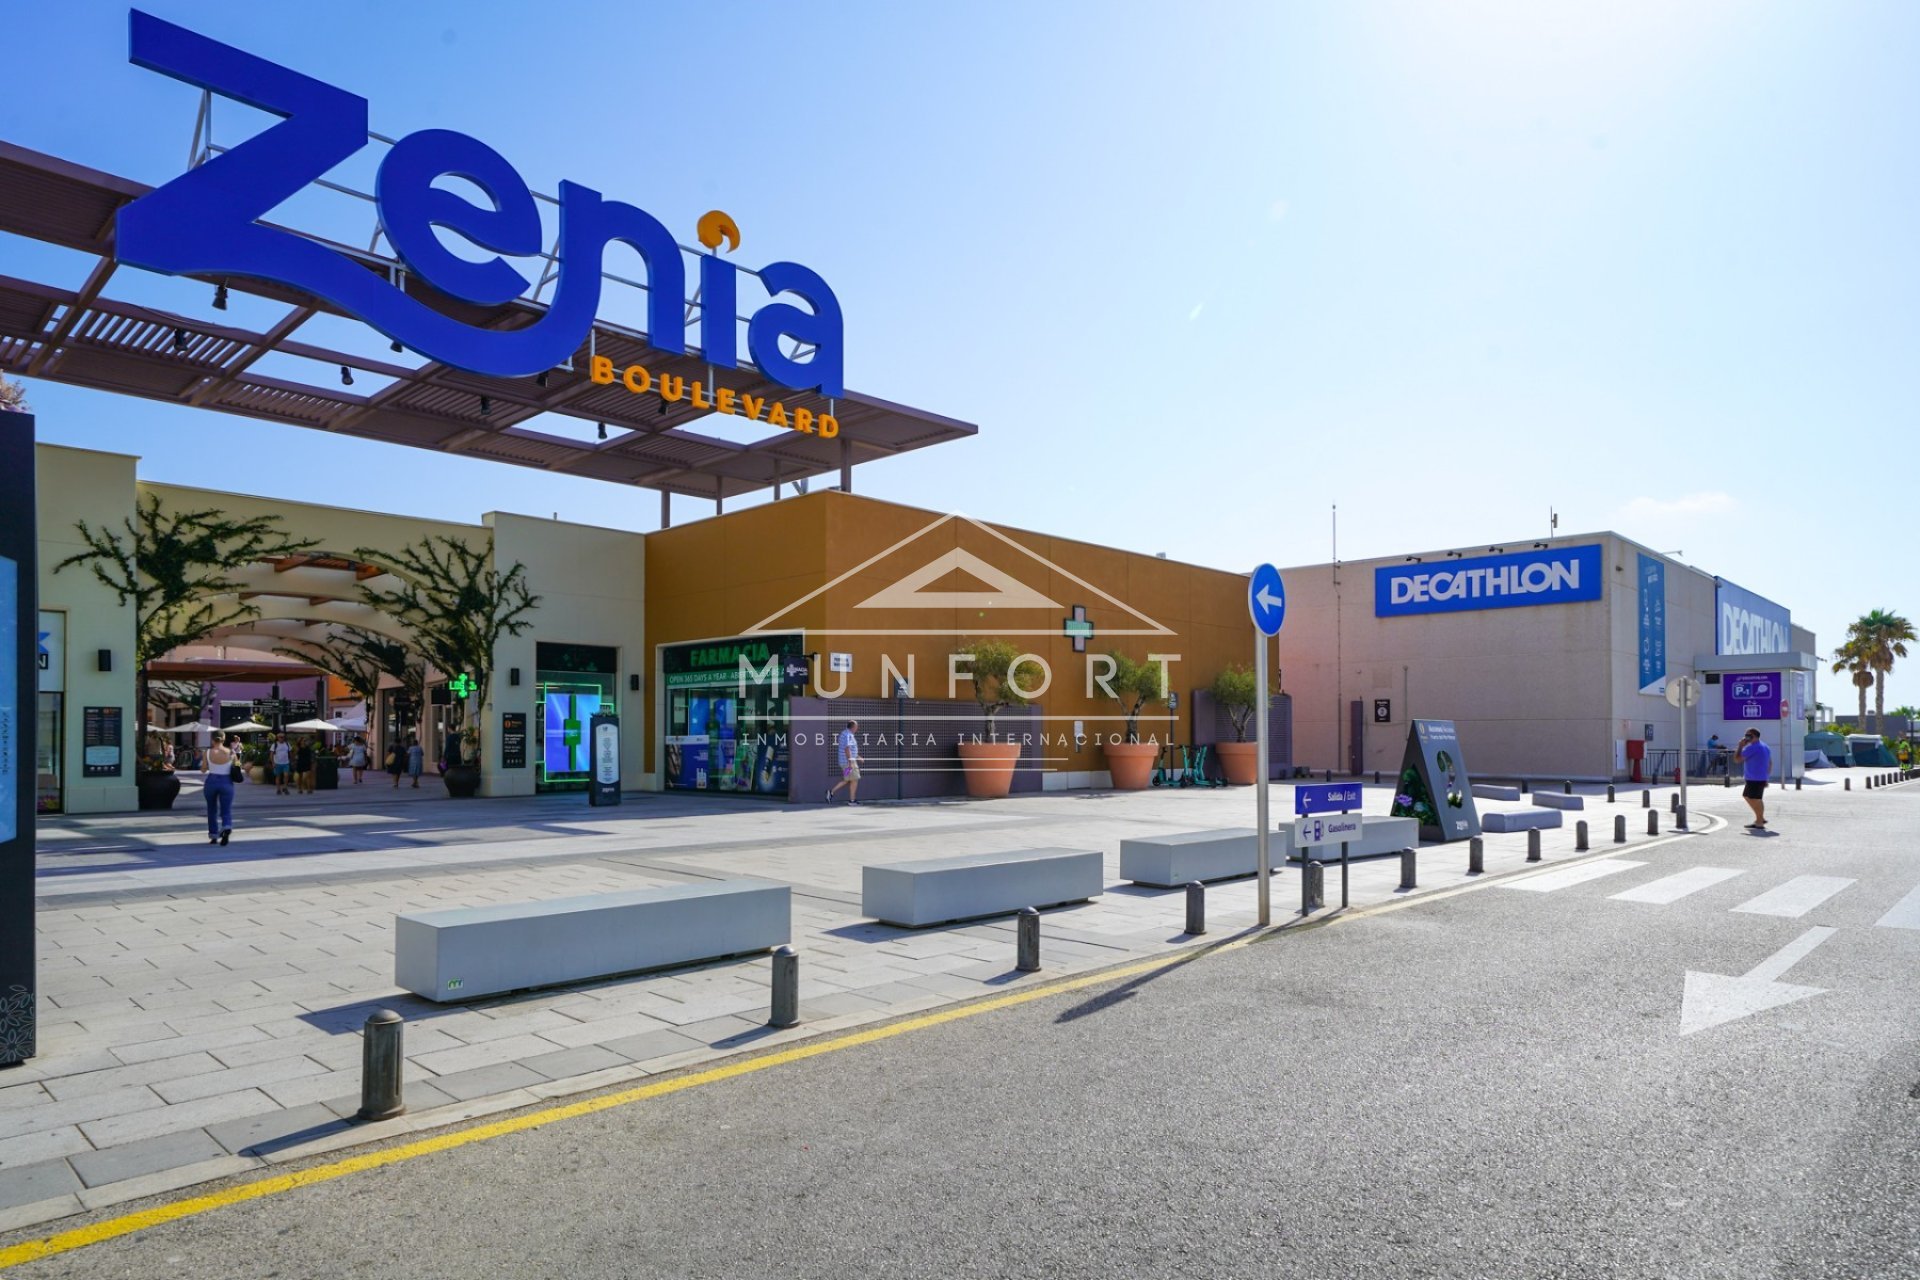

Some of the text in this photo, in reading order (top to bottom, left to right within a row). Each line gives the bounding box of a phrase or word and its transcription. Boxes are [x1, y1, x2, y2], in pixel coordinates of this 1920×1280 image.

[590, 355, 840, 440] BOULEVARD
[1391, 559, 1580, 604] DECATHLON
[691, 643, 769, 666] FARMACIA
[669, 673, 684, 684] OPEN
[694, 672, 708, 682] DAYS
[713, 671, 727, 681] YEAR
[1328, 792, 1343, 801] Salida
[1347, 791, 1356, 801] Exit
[1328, 823, 1356, 833] Gasolinera
